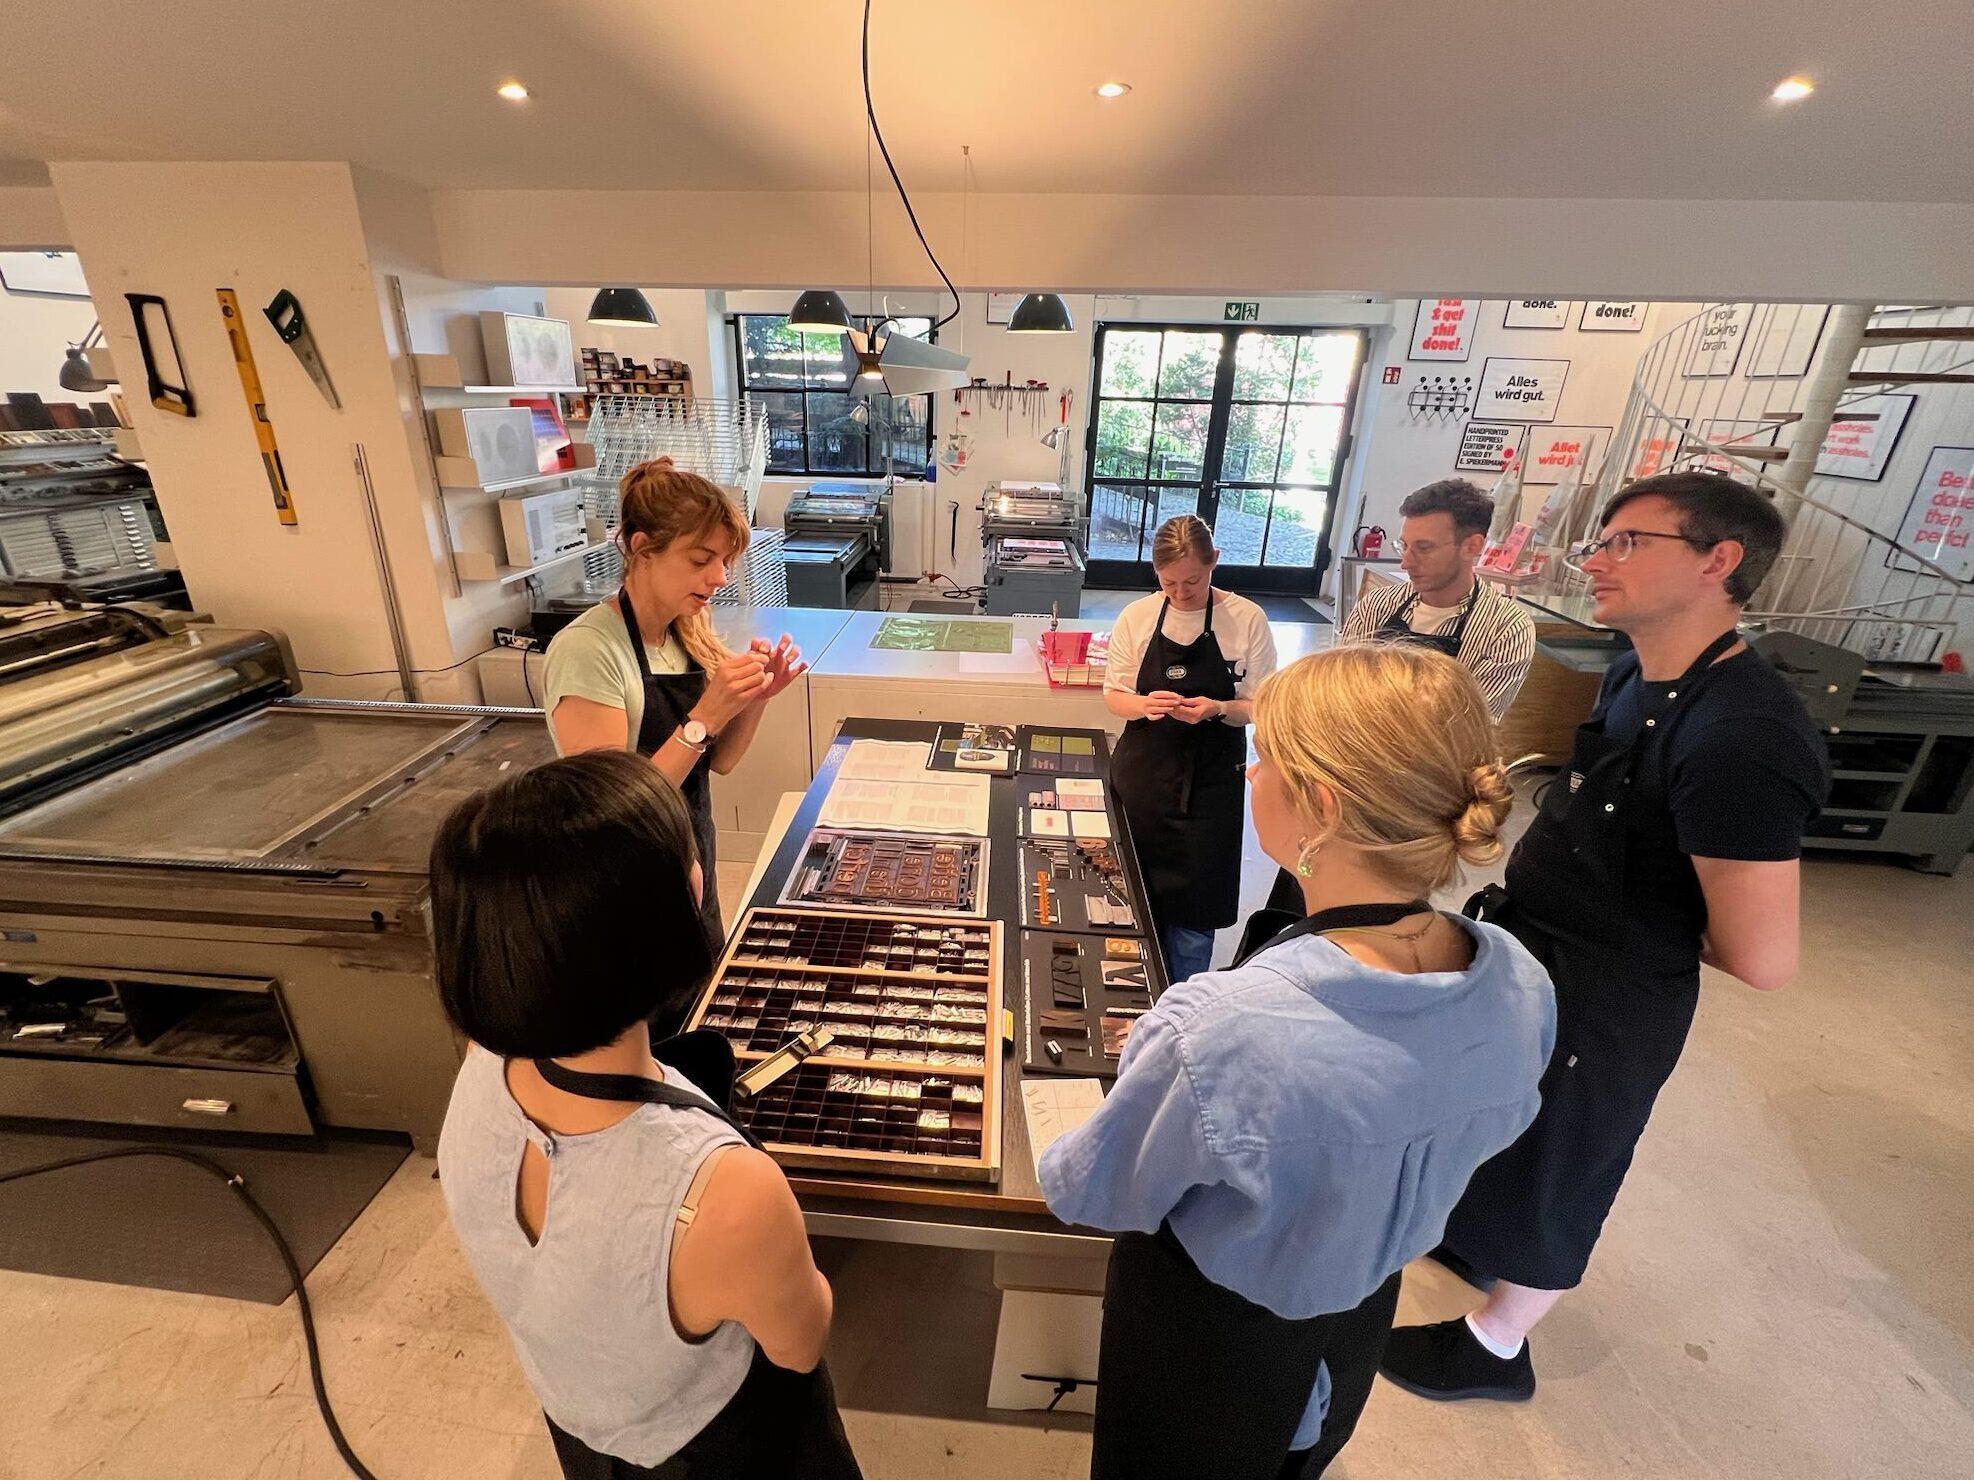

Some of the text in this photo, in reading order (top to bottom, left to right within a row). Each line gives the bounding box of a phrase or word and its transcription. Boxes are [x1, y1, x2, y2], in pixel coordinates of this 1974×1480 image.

[1443, 309, 1465, 322] get
[1596, 304, 1636, 318] done!
[1432, 323, 1457, 336] shit
[1506, 375, 1539, 388] Alles
[1495, 389, 1545, 403] wird gut.
[1468, 427, 1509, 436] HANDPRINTED
[1465, 435, 1504, 443] LETTERPRESS
[1463, 442, 1486, 450] EDITION
[1486, 443, 1494, 451] OF
[1550, 441, 1581, 453] Allet
[1538, 454, 1566, 465] wird
